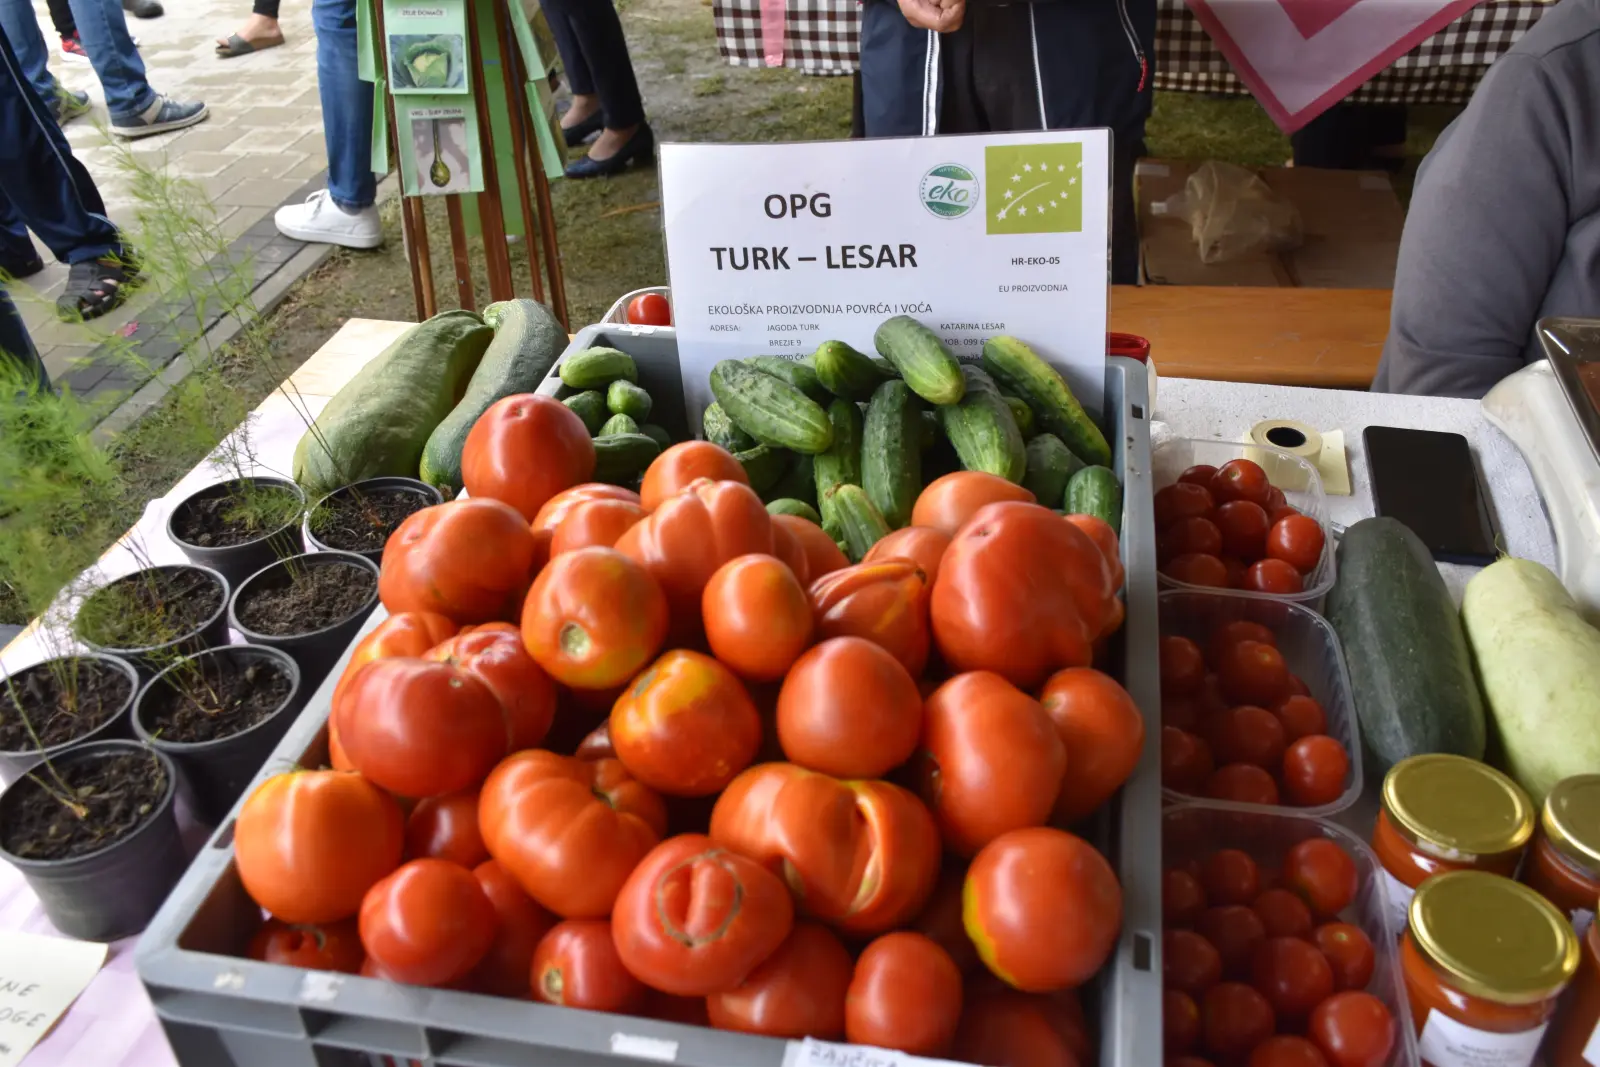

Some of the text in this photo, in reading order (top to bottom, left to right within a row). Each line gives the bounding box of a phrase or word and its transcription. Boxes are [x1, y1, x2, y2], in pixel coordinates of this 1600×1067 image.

[928, 180, 969, 203] eko
[764, 192, 832, 219] OPG
[709, 246, 791, 271] TURK
[825, 243, 918, 270] LESAR
[1011, 256, 1061, 266] HR-EKO-05
[998, 284, 1069, 293] EU PROIZVODNJA
[708, 301, 933, 315] EKOLOŠKA PROIZVODNJA POVRĆA I VOĆA
[710, 324, 741, 332] ADRESA:
[767, 324, 798, 332] JAGODA
[769, 339, 795, 347] BREZJE
[963, 338, 978, 346] 099
[795, 352, 808, 361] ČA
